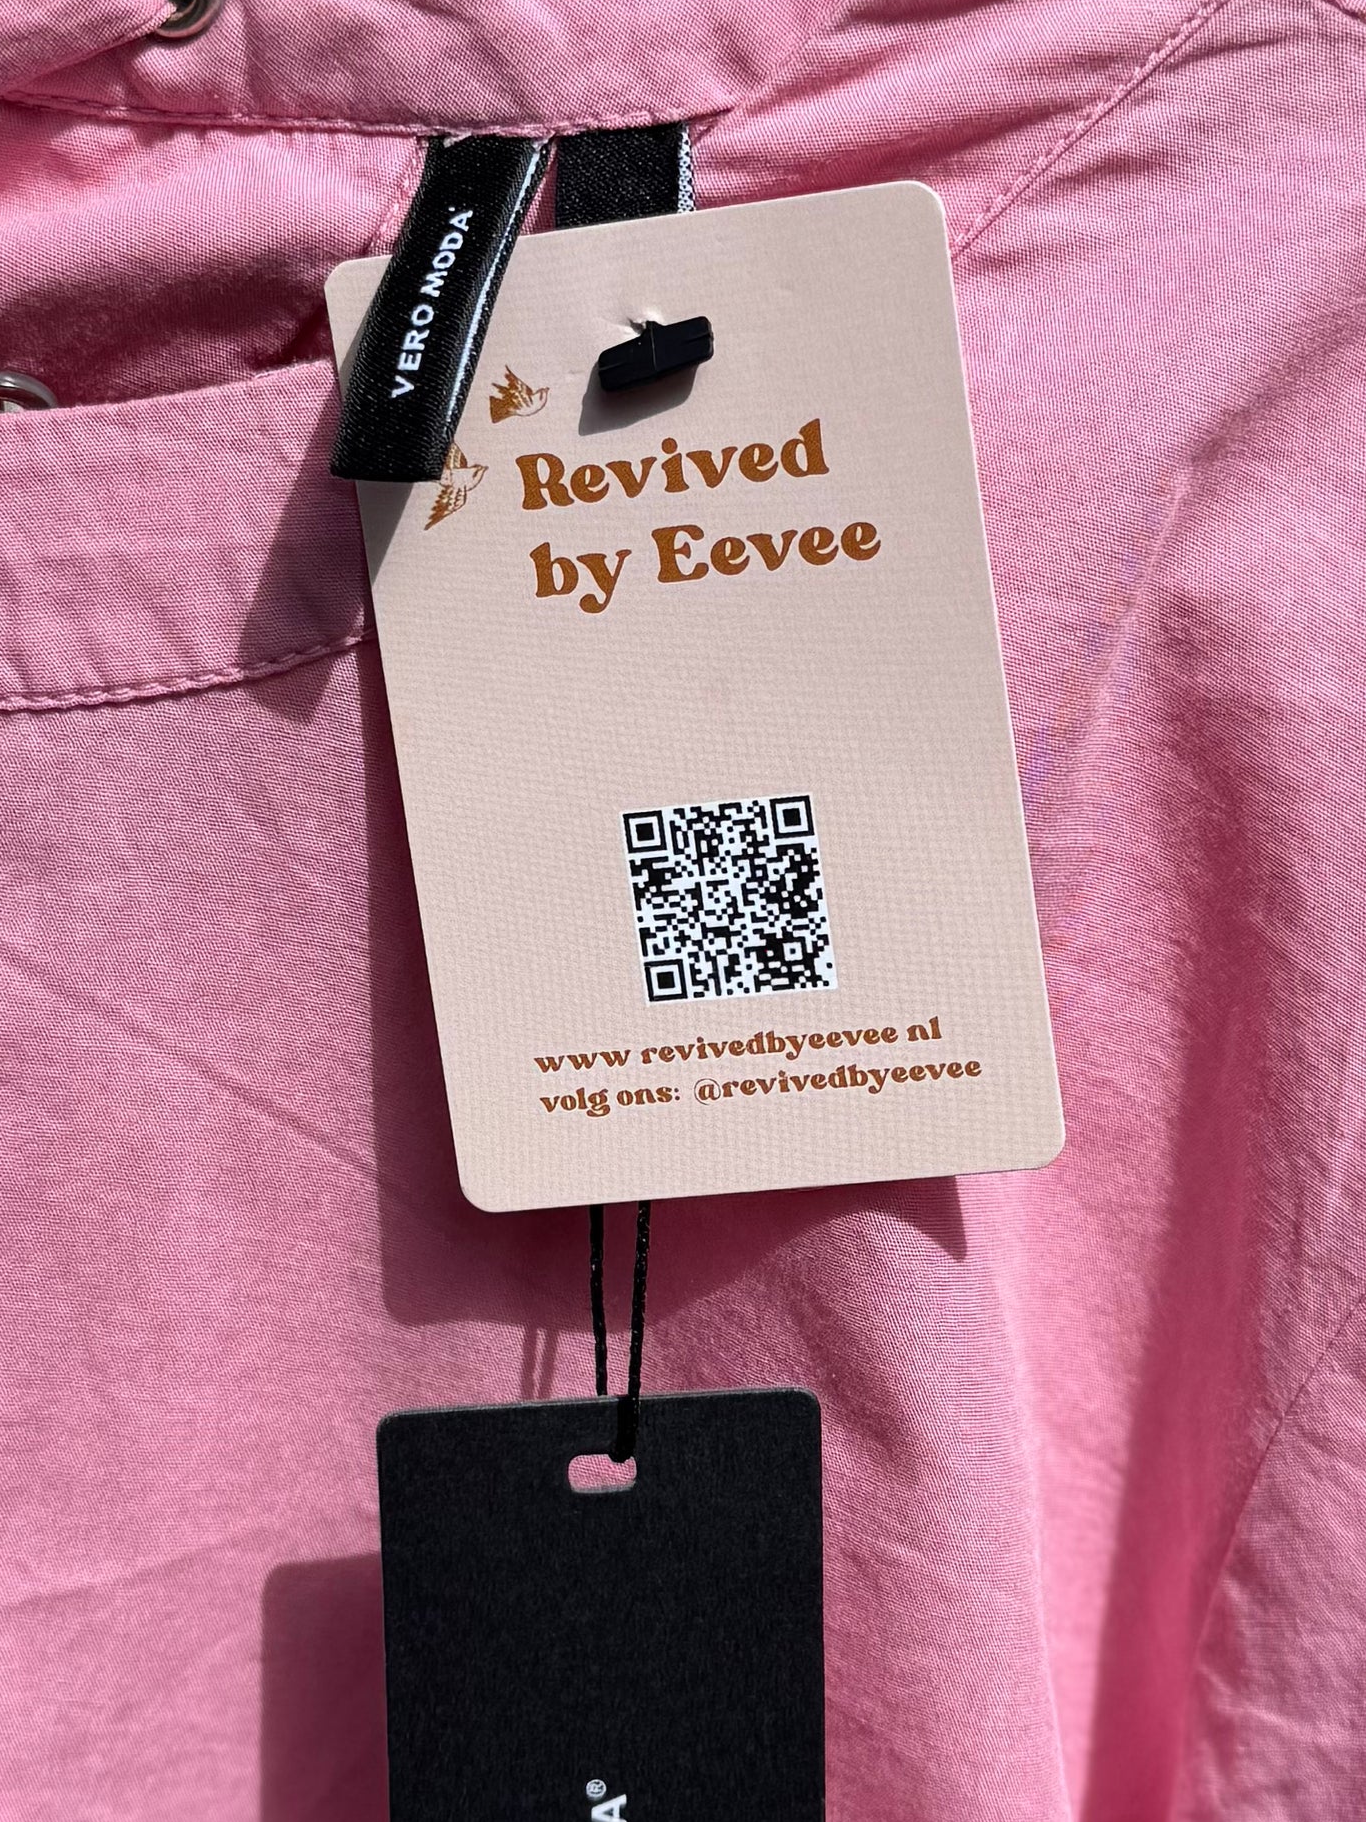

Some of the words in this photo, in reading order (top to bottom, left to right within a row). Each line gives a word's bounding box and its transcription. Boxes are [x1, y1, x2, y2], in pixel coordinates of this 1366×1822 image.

[391, 303, 435, 398] VERO
[515, 418, 829, 512] Revived
[529, 542, 631, 615] by
[651, 521, 882, 585] Eevee
[540, 1087, 612, 1118] volg
[616, 1086, 681, 1107] ons:
[693, 1060, 983, 1106] @revivedbyeevee
